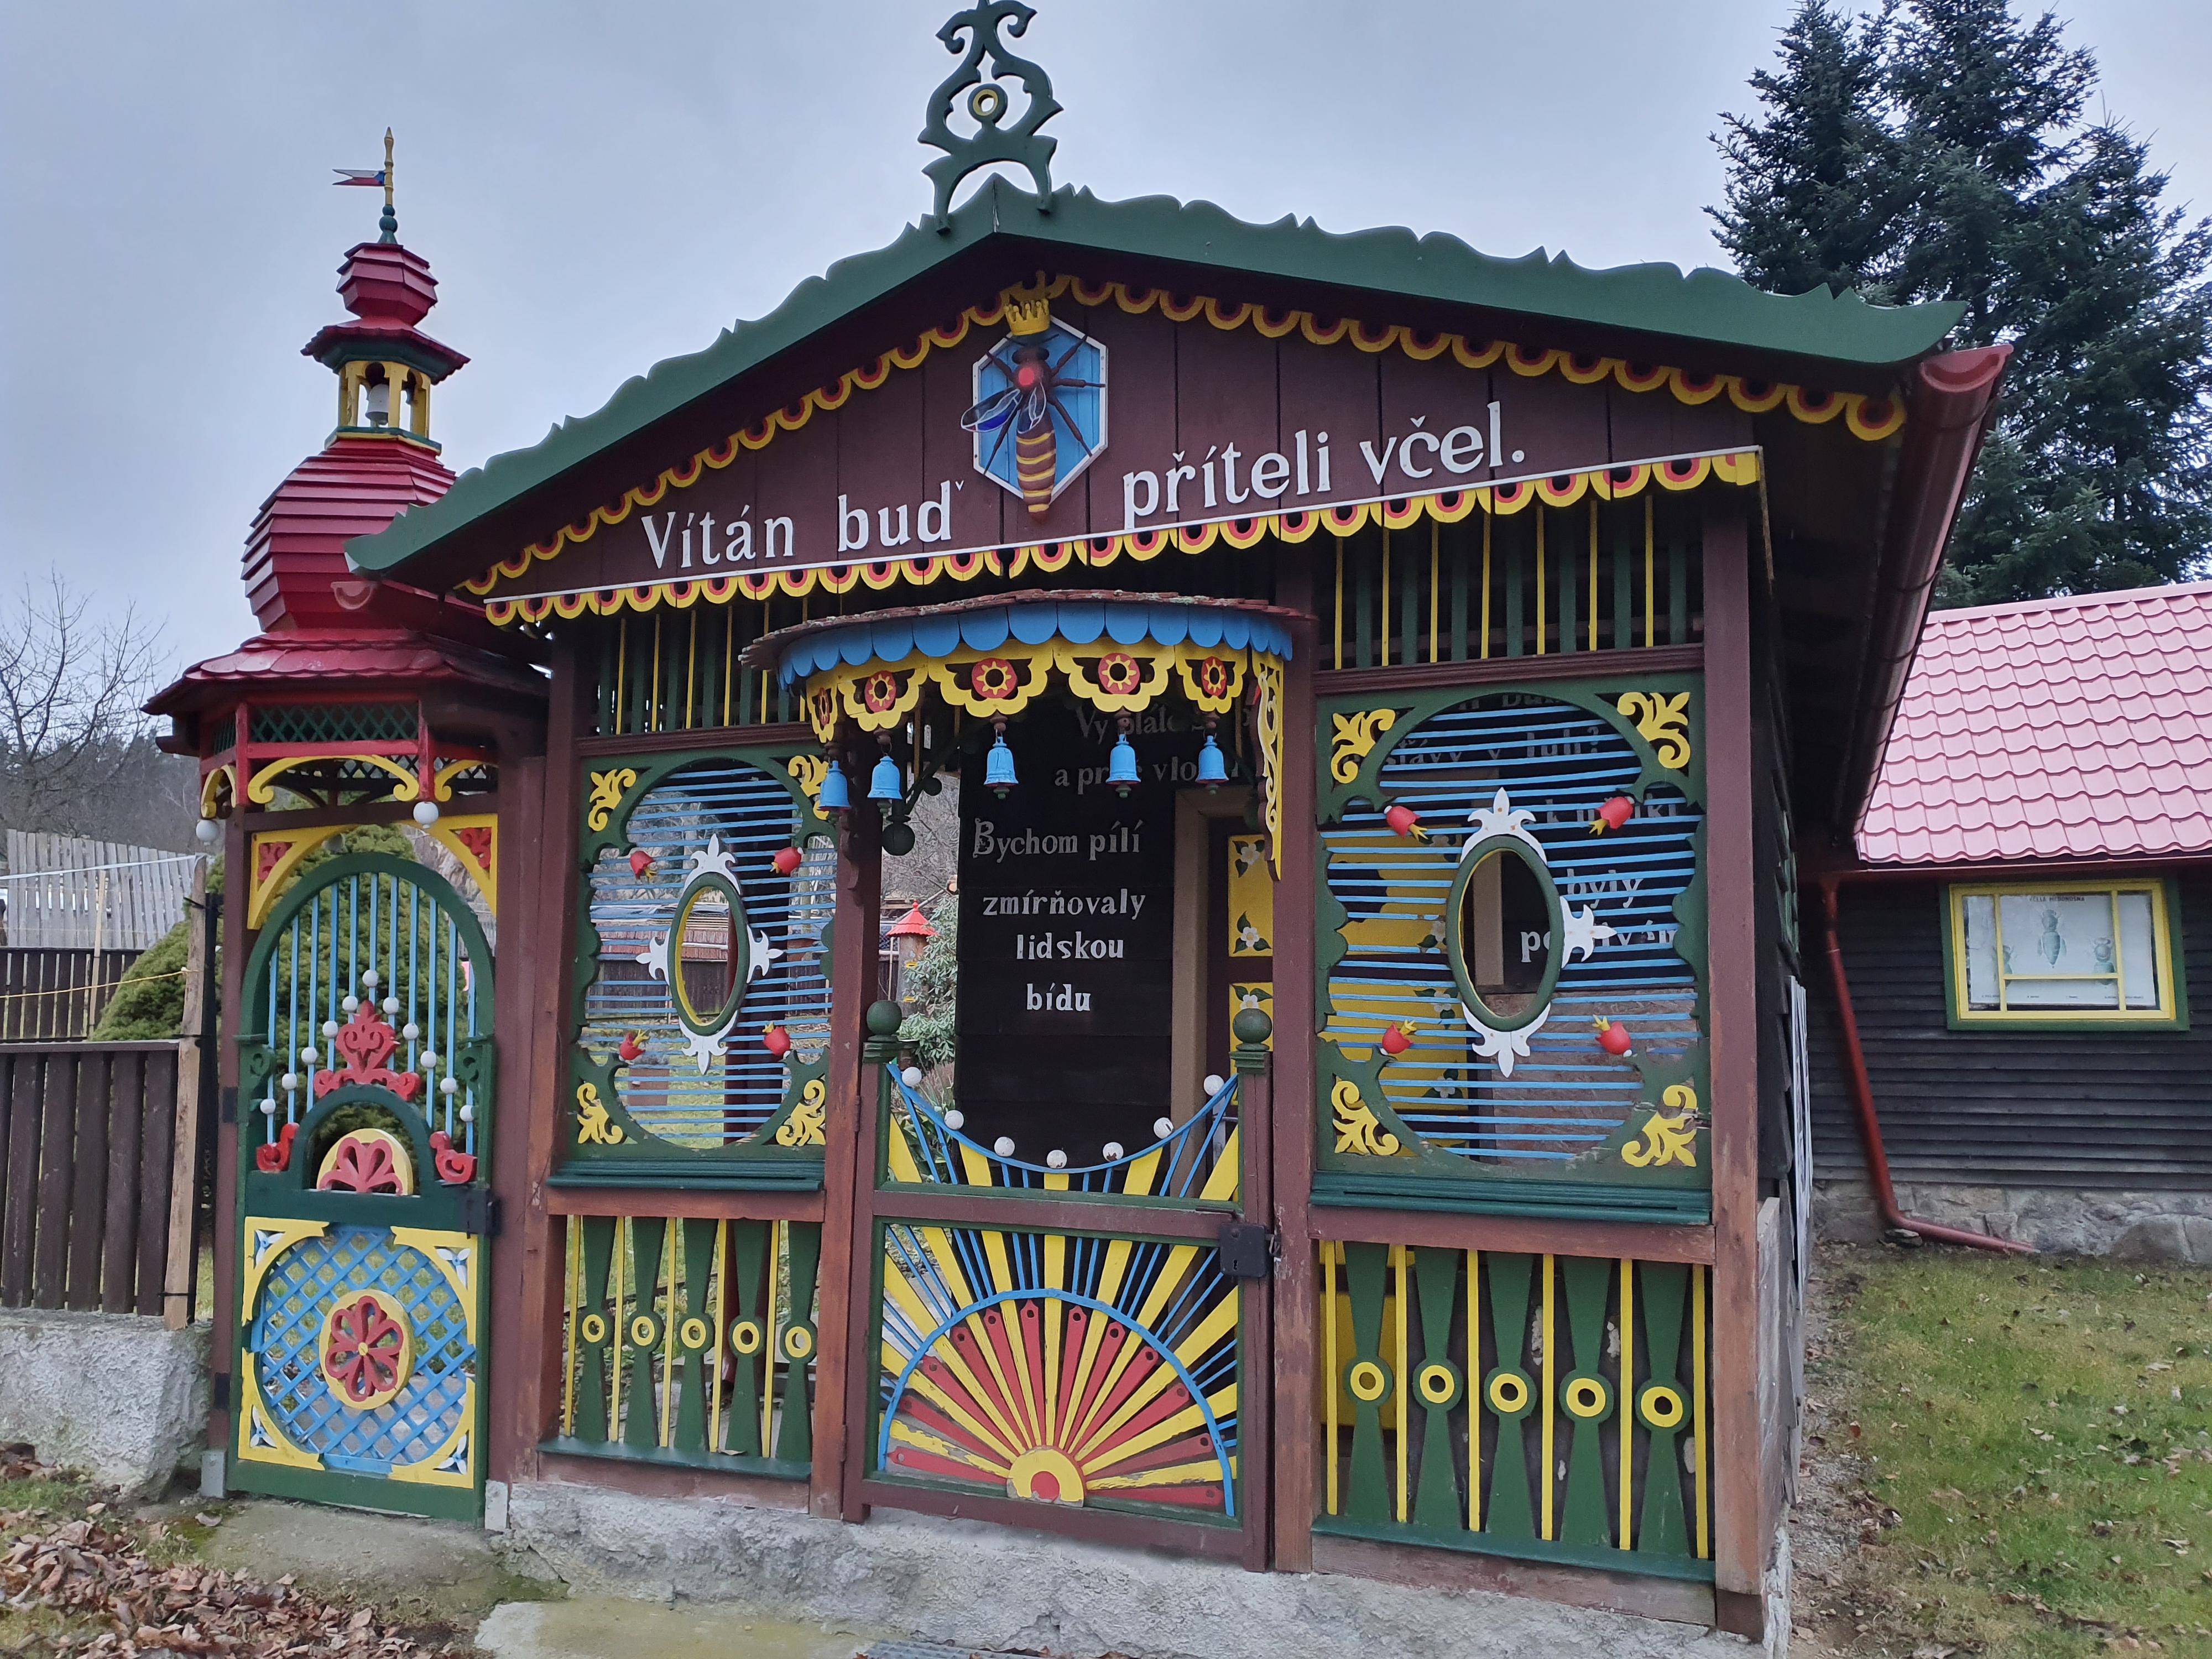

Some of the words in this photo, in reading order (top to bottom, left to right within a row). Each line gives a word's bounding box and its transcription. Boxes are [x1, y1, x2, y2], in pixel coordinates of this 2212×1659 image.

[641, 504, 795, 570] Vítán
[837, 479, 964, 552] buď
[1123, 428, 1332, 530] příteli
[1359, 401, 1525, 485] včel.
[1055, 768, 1070, 787] a
[972, 817, 1078, 863] Bychom
[1088, 819, 1143, 861] pílí
[982, 888, 1146, 920] zmírňovaly
[1566, 868, 1645, 909] byly
[1016, 931, 1124, 961] lidskou
[1026, 983, 1092, 1012] bídu
